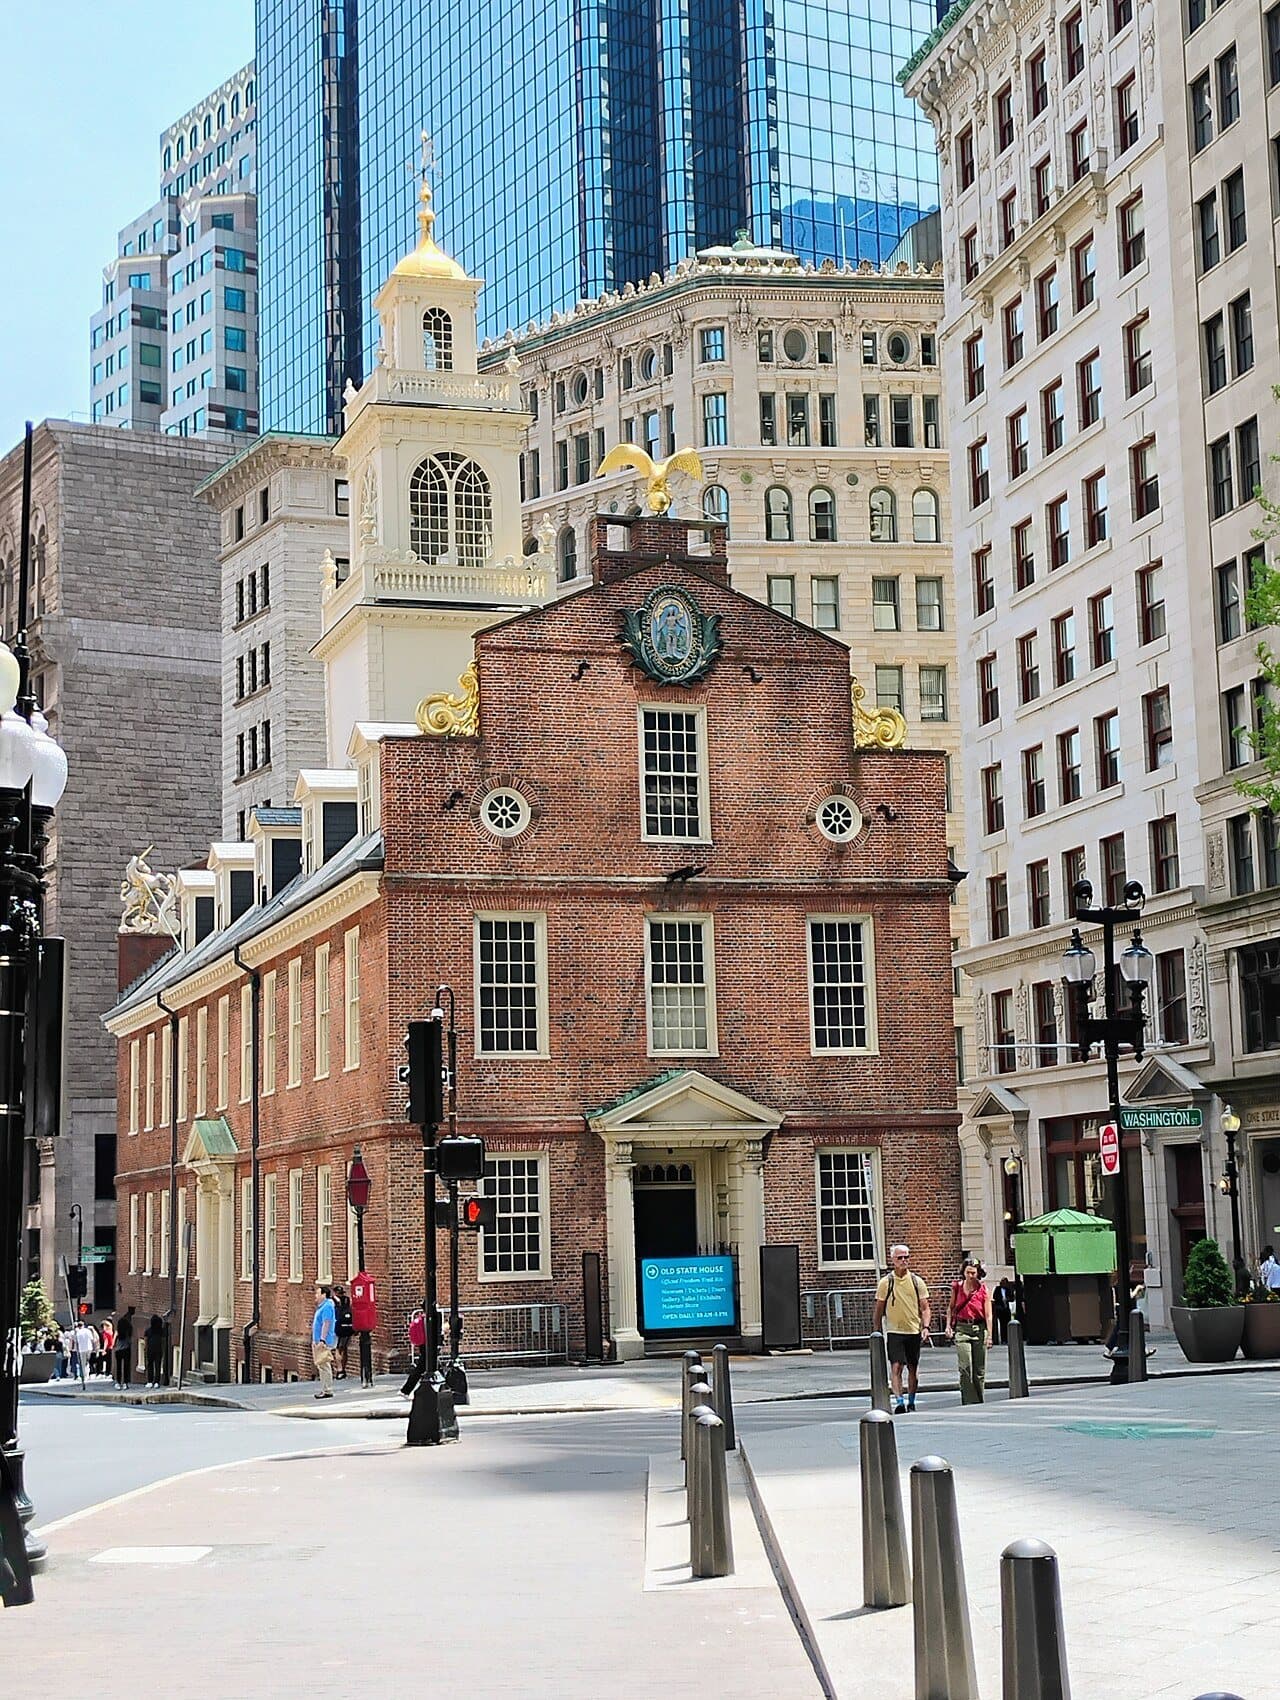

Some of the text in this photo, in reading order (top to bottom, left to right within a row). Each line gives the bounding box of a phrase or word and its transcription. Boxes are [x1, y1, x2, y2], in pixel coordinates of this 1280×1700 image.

[1123, 1112, 1191, 1127] WASHINGTON
[1262, 1110, 1280, 1121] STATE
[661, 1267, 675, 1275] OLD
[676, 1267, 697, 1275] STATE
